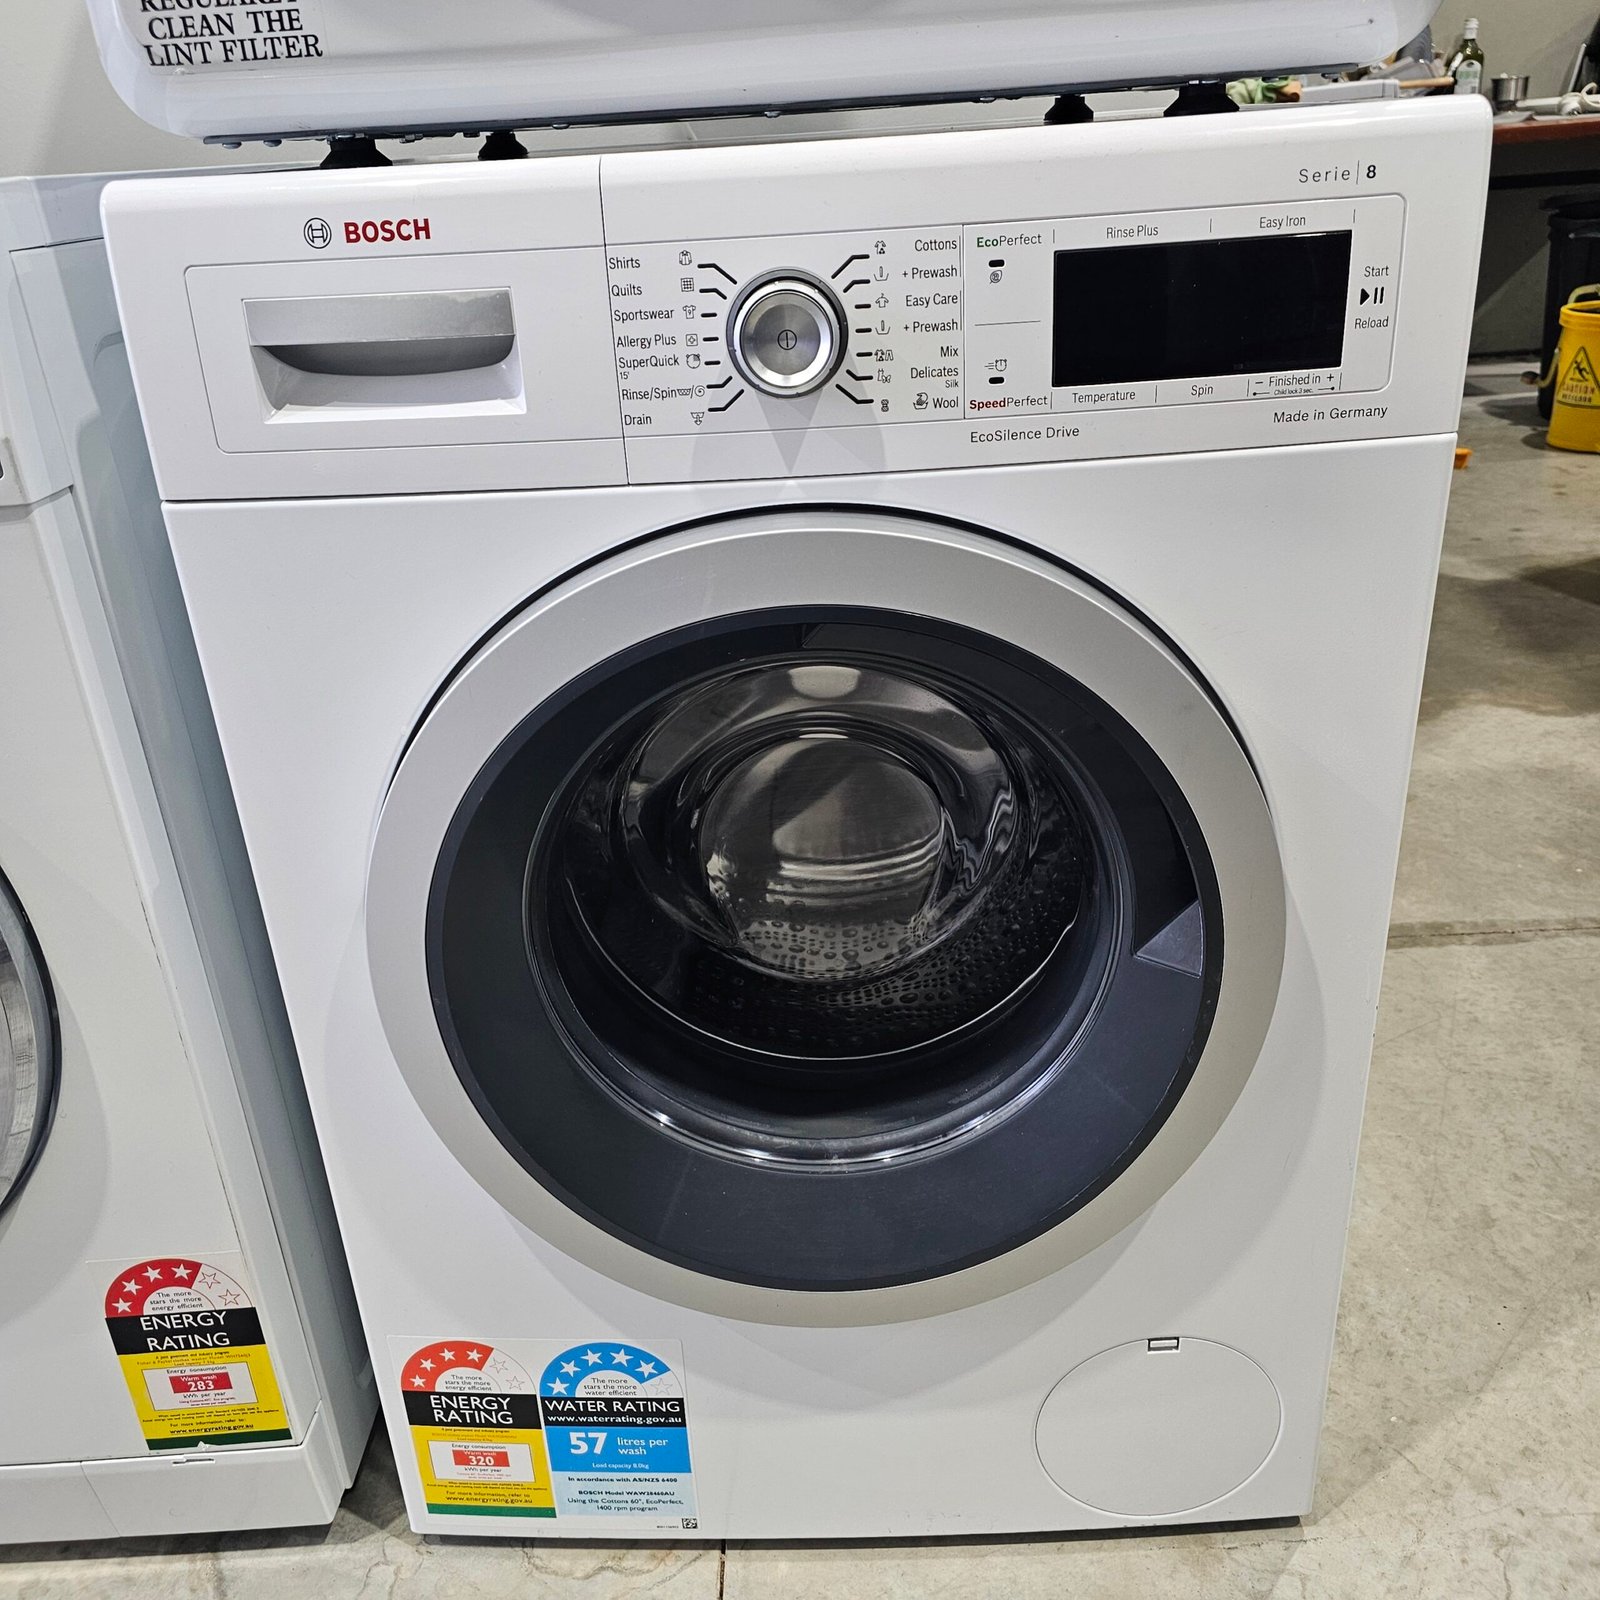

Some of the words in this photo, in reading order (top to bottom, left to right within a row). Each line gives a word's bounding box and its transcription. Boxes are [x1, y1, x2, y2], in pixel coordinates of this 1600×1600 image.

[149, 12, 235, 40] CLEAN
[246, 8, 303, 34] THE
[144, 42, 212, 66] LINT
[220, 34, 323, 63] FILTER
[1299, 166, 1351, 183] Serie
[1366, 164, 1377, 179] 8
[1259, 216, 1284, 230] Easy
[1286, 215, 1306, 227] Iron
[344, 218, 431, 244] BOSCH
[1106, 226, 1135, 239] Rinse
[1137, 224, 1159, 237] Plus
[914, 239, 958, 252] Cottons
[976, 233, 1042, 248] EcoPerfect
[608, 256, 641, 270] Shirts
[912, 264, 958, 279] Prewash
[1364, 265, 1389, 278] Start
[611, 284, 642, 297] Quilts
[906, 294, 930, 308] Easy
[933, 292, 958, 305] Care
[614, 309, 674, 324] Sportswear
[1354, 316, 1389, 329] Reload
[913, 318, 958, 333] Prewash
[616, 336, 652, 350] Allergy
[654, 334, 677, 346] Plus
[940, 345, 959, 358] Mix
[618, 354, 680, 370] SuperQuick
[910, 366, 959, 379] Delicates
[1269, 373, 1310, 387] Finished
[1312, 373, 1321, 384] in
[945, 379, 959, 389] Silk
[1190, 384, 1214, 398] Spin
[621, 387, 677, 401] Rinse/Spin
[1072, 390, 1136, 404] Temperature
[932, 396, 959, 409] Wool
[969, 395, 1048, 411] SpeedPerfect
[624, 414, 652, 426] Drain
[1273, 410, 1309, 423] Made
[1313, 407, 1325, 420] in
[1329, 406, 1388, 419] Germany
[970, 428, 1042, 443] EcoSilence
[1046, 426, 1080, 439] Drive
[140, 1311, 226, 1331] ENERGY
[146, 1332, 230, 1351] RATING
[187, 1380, 215, 1392] 283
[430, 1395, 511, 1411] ENERGY
[545, 1400, 607, 1412] WATER
[613, 1401, 680, 1413] RATING
[433, 1409, 513, 1425] RATING
[547, 1415, 682, 1425] www.waterrating.gov.au
[569, 1431, 608, 1455] 57
[617, 1436, 646, 1446] litres
[649, 1439, 669, 1449] per
[618, 1446, 647, 1455] wash
[468, 1456, 494, 1466] 320
